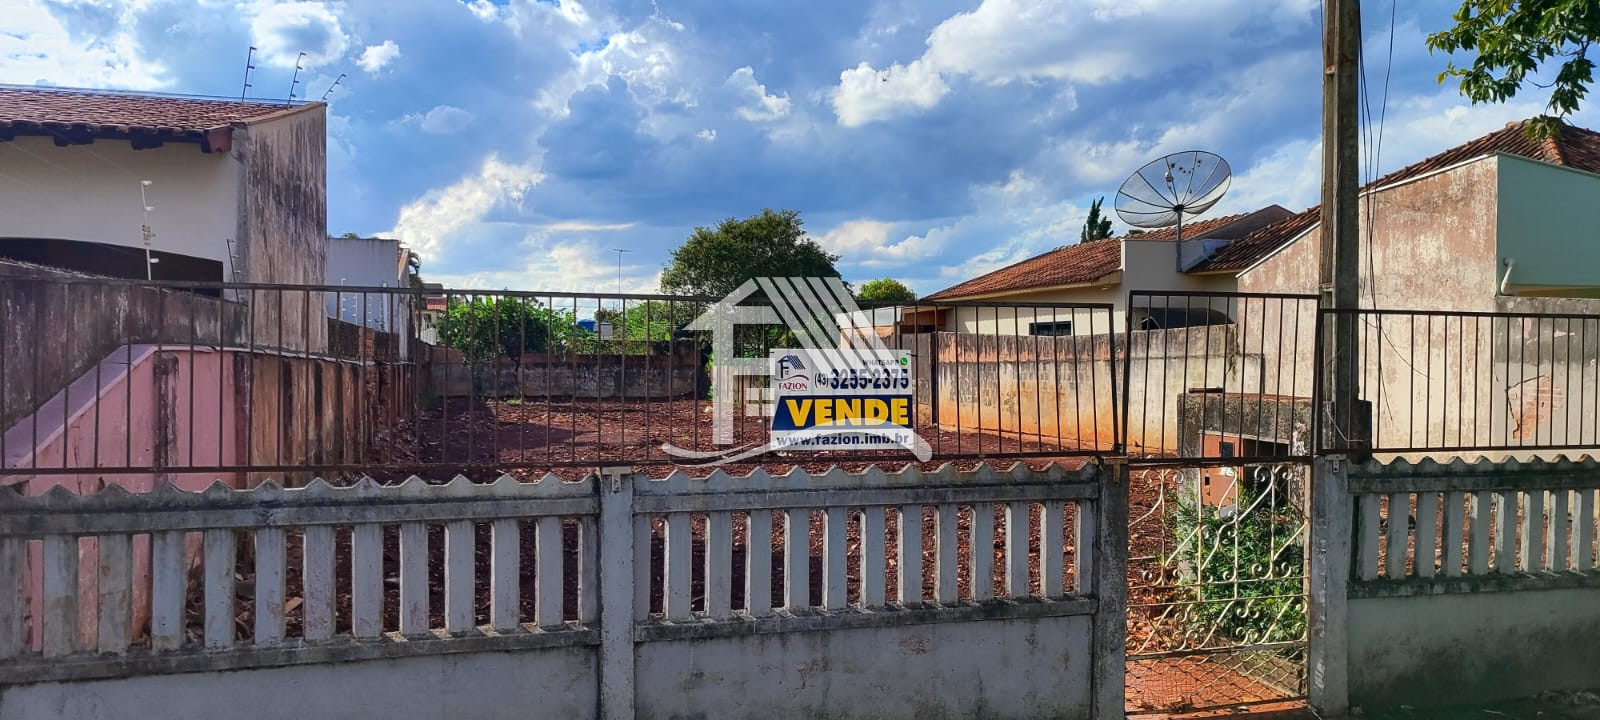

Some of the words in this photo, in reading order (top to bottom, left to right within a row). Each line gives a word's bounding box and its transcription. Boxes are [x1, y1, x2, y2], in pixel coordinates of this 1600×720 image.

[778, 382, 808, 390] FAZION
[814, 372, 829, 388] (43)
[830, 368, 909, 389] 3255-2375
[785, 398, 909, 427] VENDE
[777, 433, 909, 446] www.fazion.imb.br
